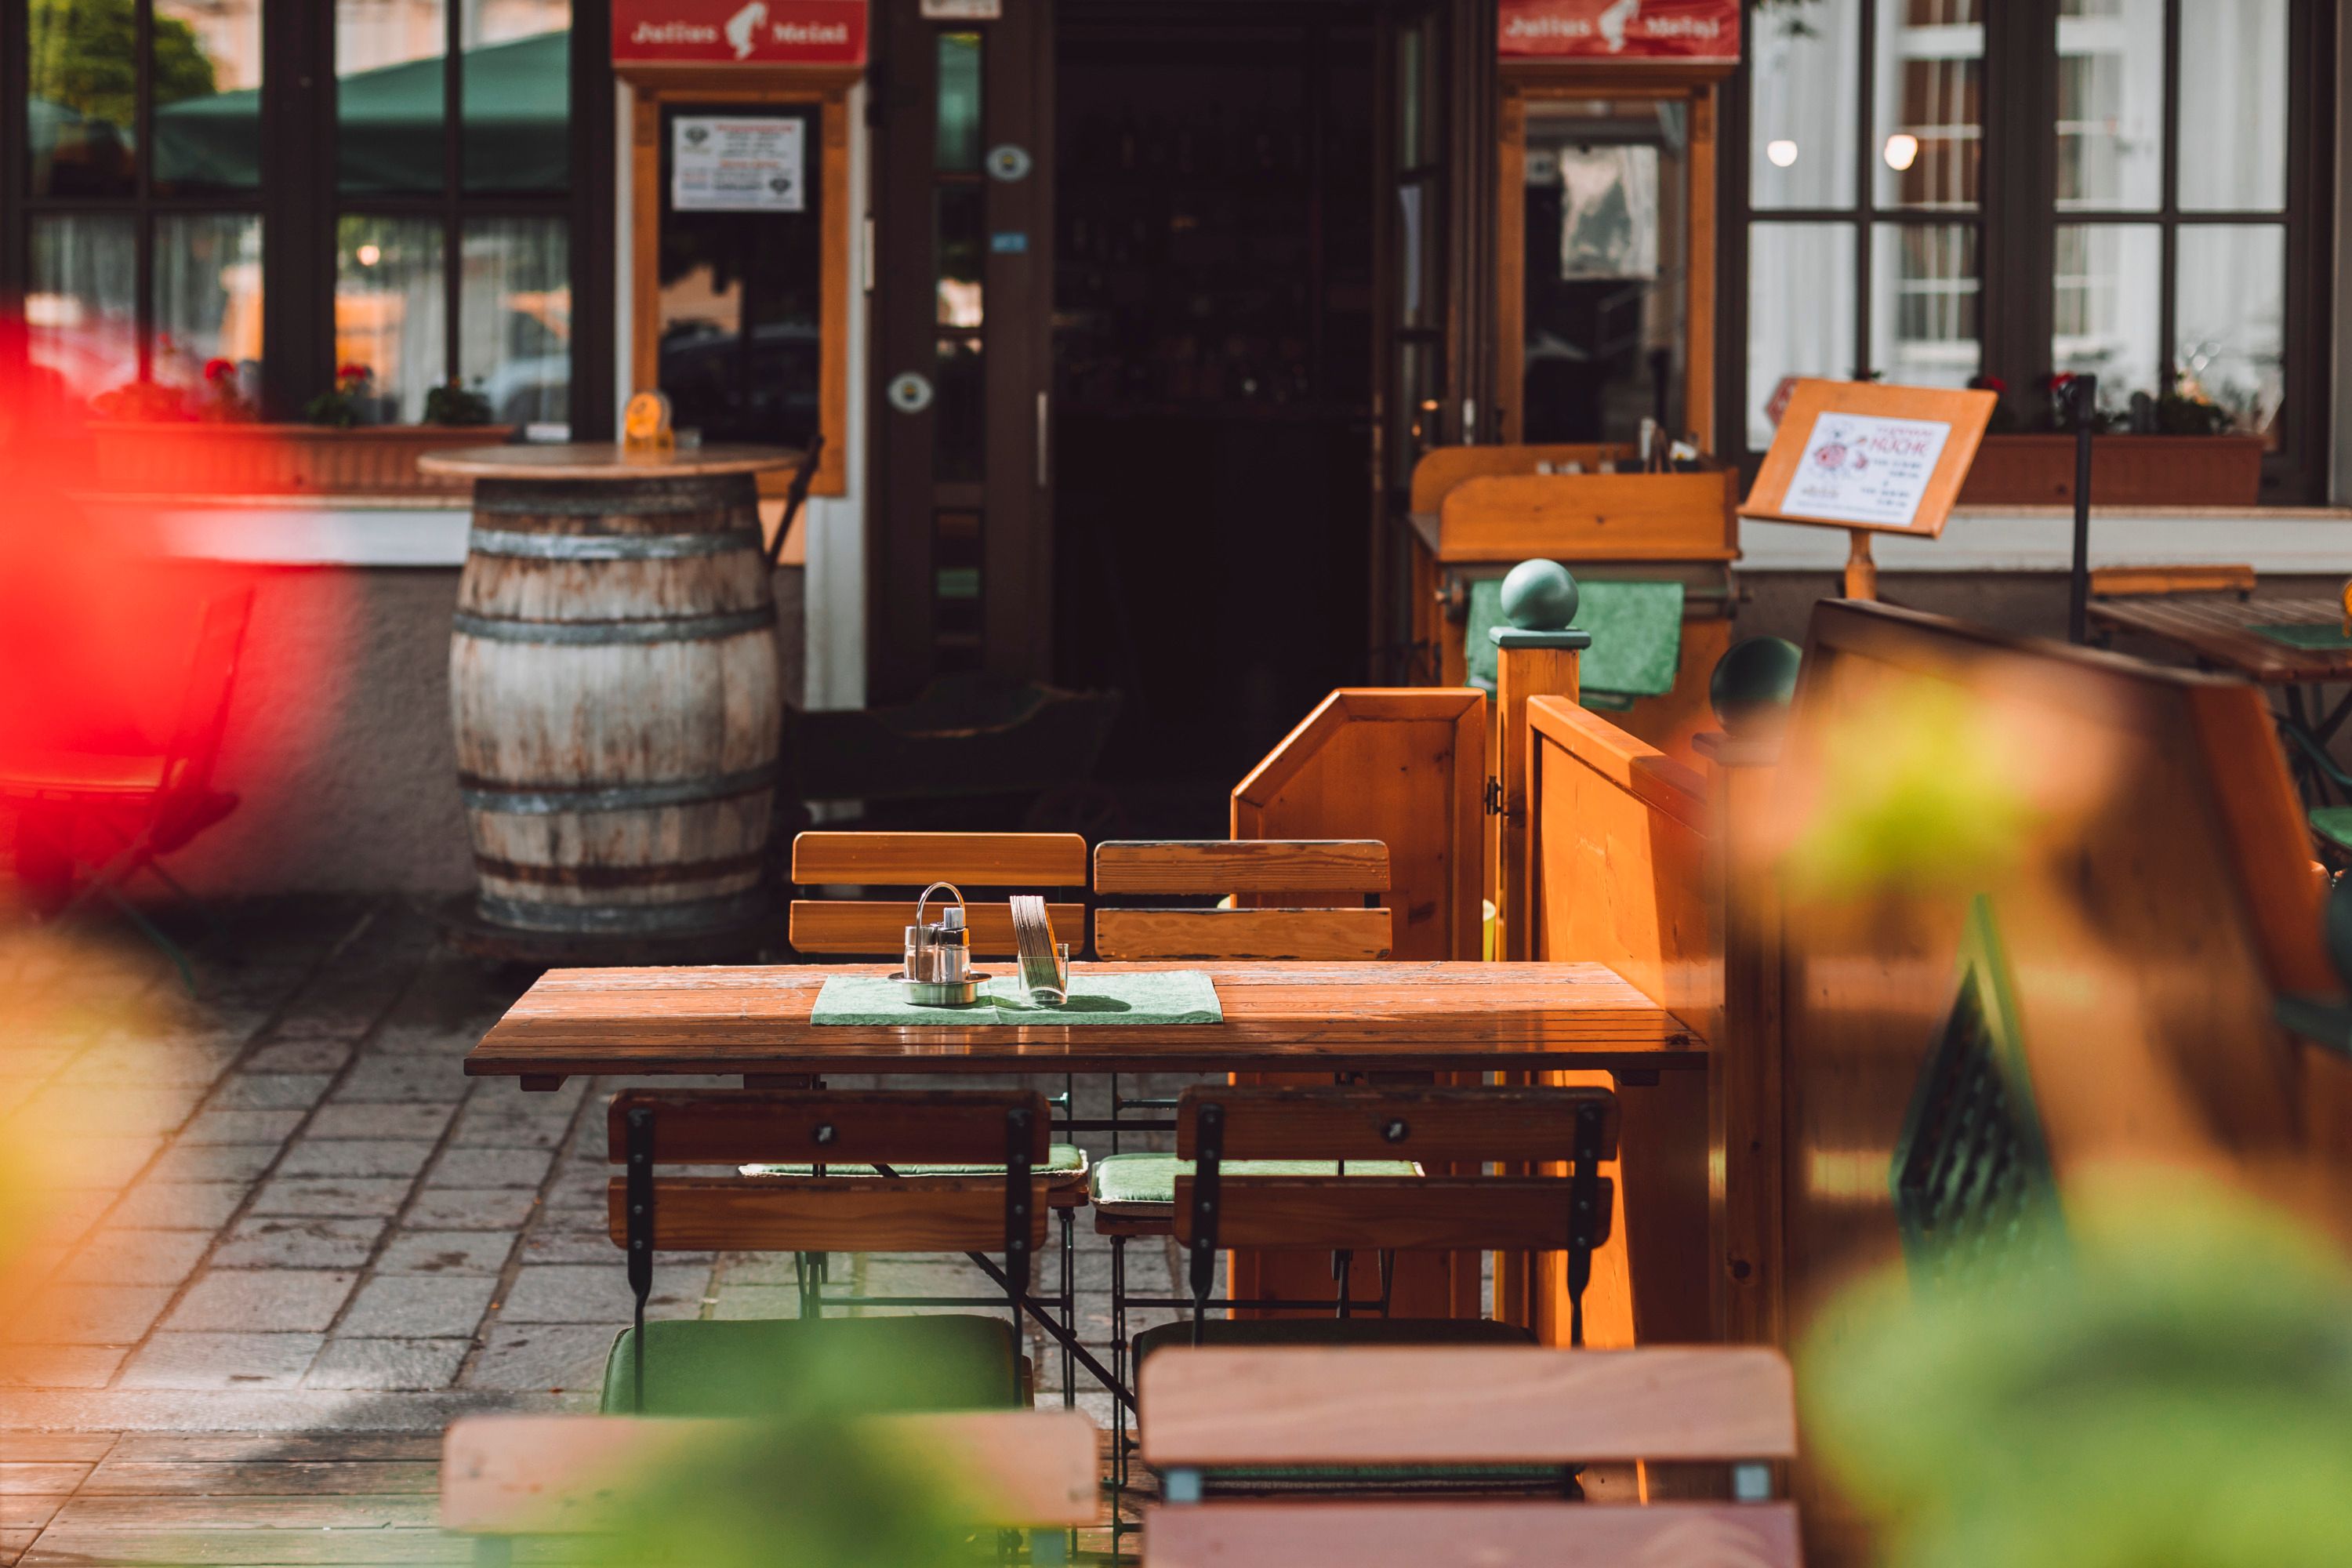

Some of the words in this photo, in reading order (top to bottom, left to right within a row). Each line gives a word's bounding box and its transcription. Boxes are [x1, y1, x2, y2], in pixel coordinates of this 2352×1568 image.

[631, 21, 717, 43] Julius
[773, 21, 848, 43] Meinl
[1506, 16, 1590, 37] Julius
